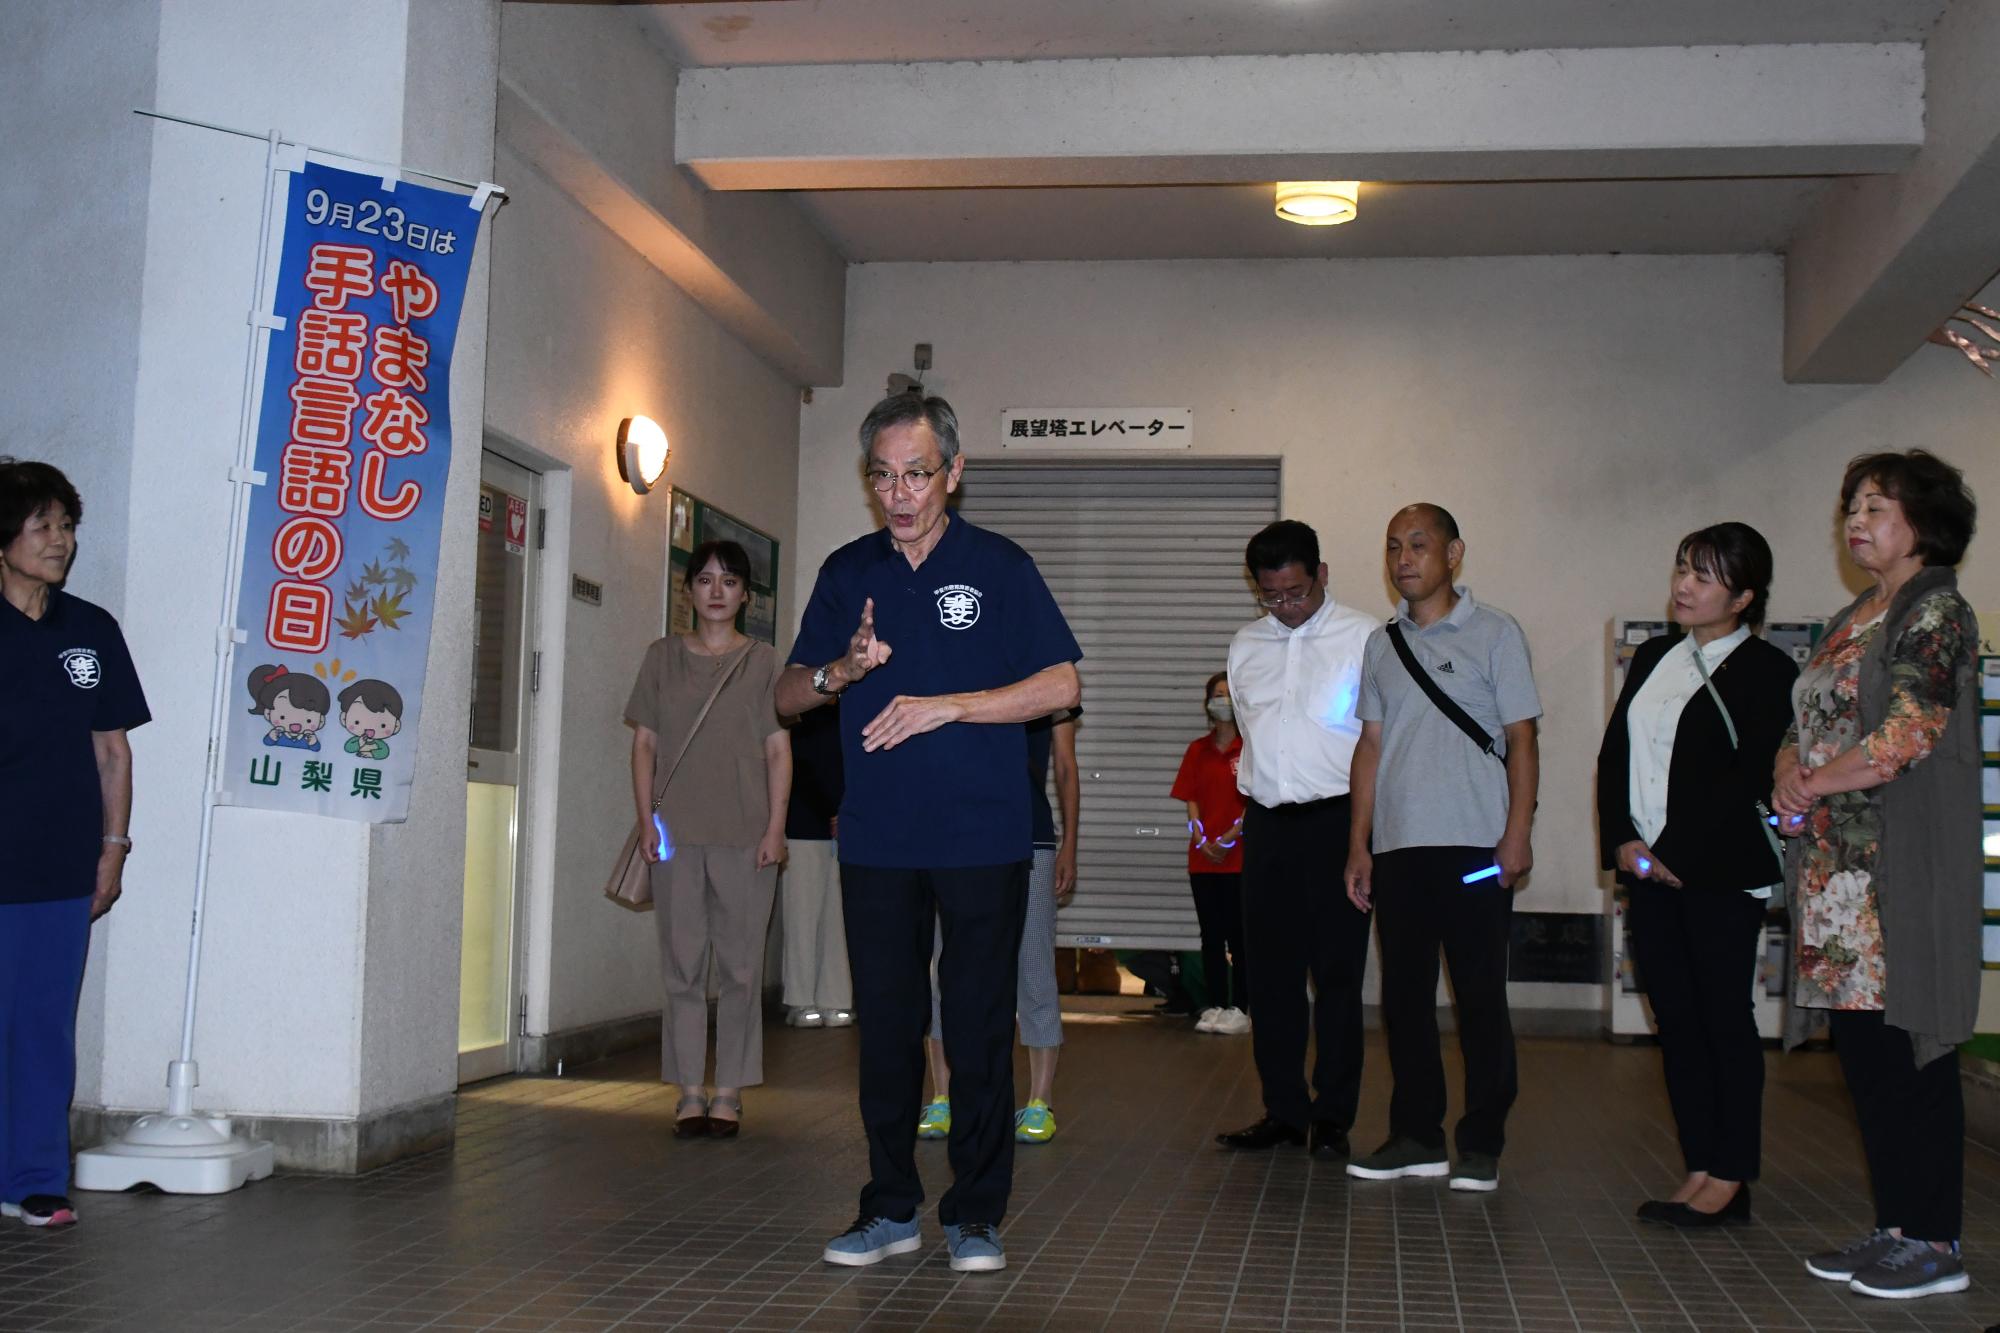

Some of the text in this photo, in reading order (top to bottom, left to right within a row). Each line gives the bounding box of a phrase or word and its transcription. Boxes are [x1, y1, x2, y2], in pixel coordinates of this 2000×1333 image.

[305, 188, 457, 255] 9月23日は
[358, 260, 438, 519] やまなし
[266, 244, 375, 653] 手話言語の日
[1009, 419, 1186, 438] 展望塔エレベーター
[249, 754, 382, 799] 山梨県
